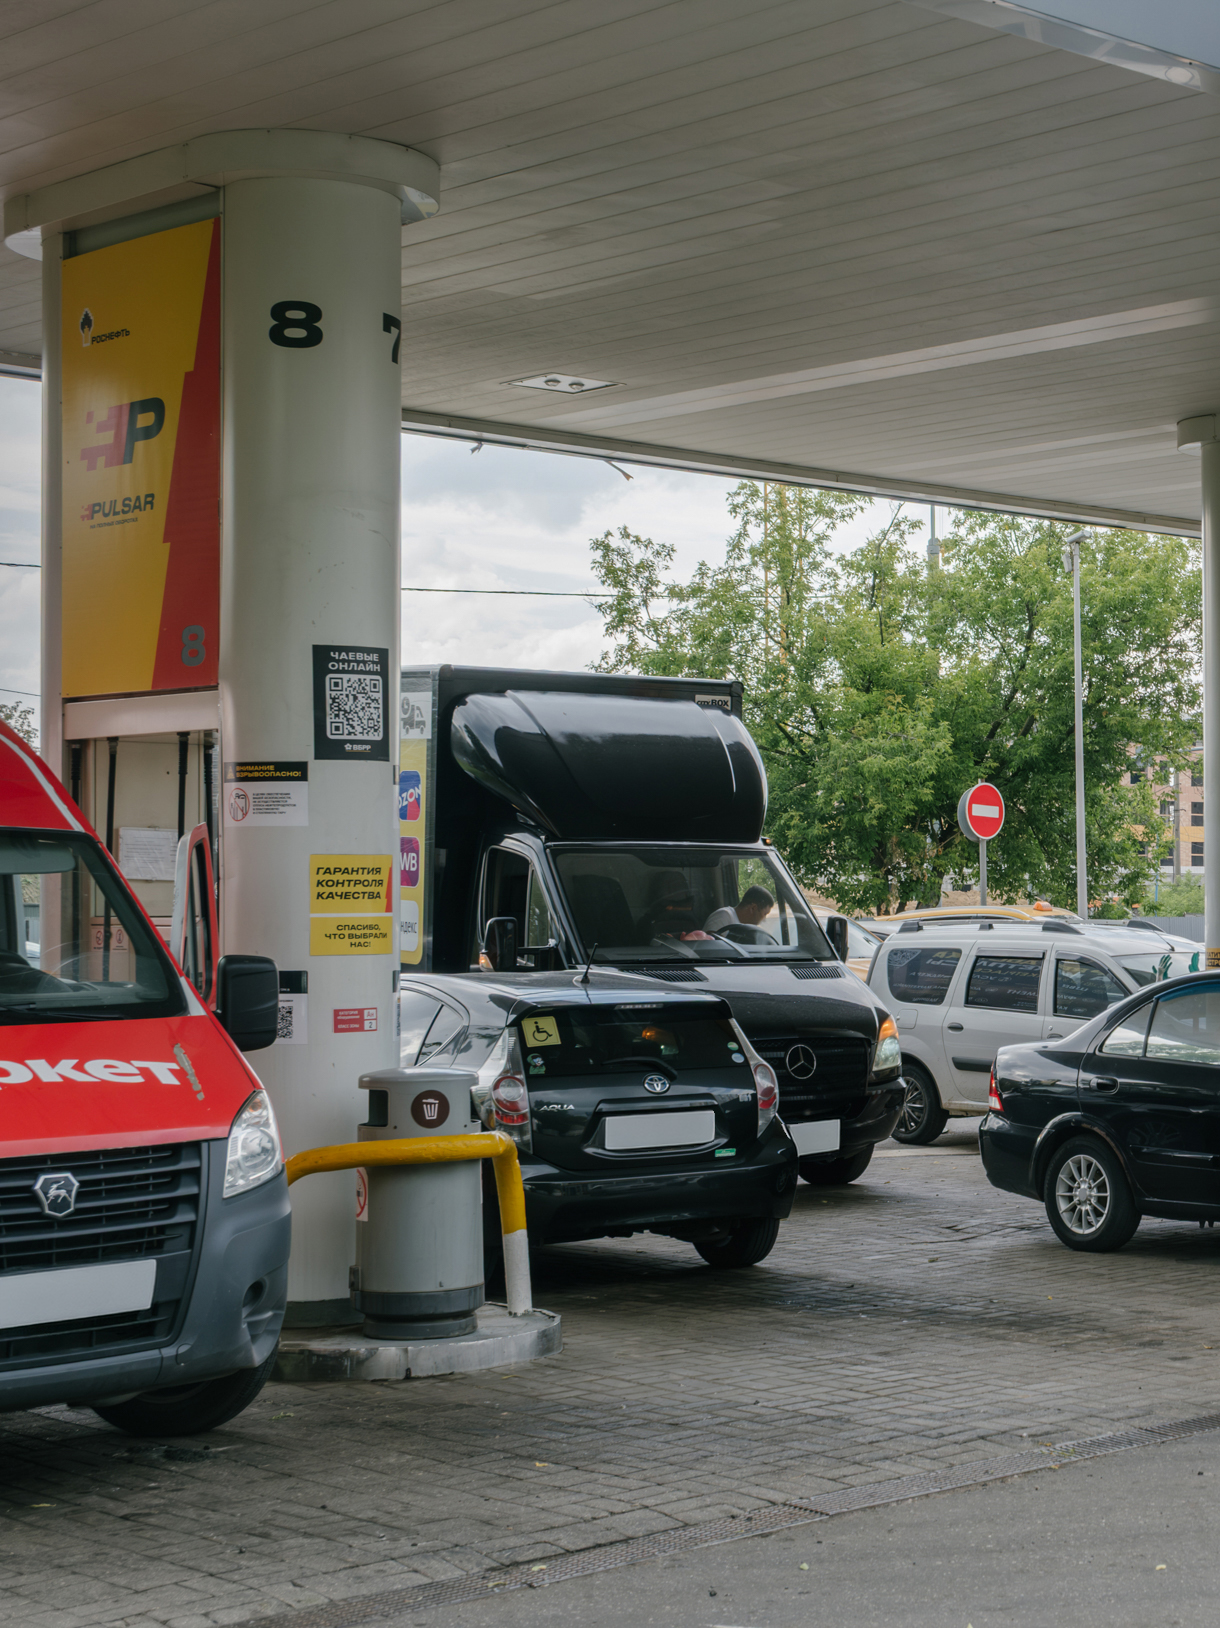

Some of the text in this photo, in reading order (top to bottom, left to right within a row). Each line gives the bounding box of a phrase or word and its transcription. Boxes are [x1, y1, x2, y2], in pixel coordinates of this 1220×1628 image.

[269, 300, 324, 348] 8
[92, 328, 130, 344] РОСНЕФТЬ
[383, 312, 402, 364] 7
[90, 493, 155, 520] PULSAR
[181, 624, 206, 666] 8
[330, 652, 379, 661] ЧАЕВЫЕ
[328, 662, 380, 672] ОНЛАЙН
[400, 852, 417, 871] WB
[316, 867, 381, 875] ГАРАНТИЯ
[400, 919, 418, 934] ндекс
